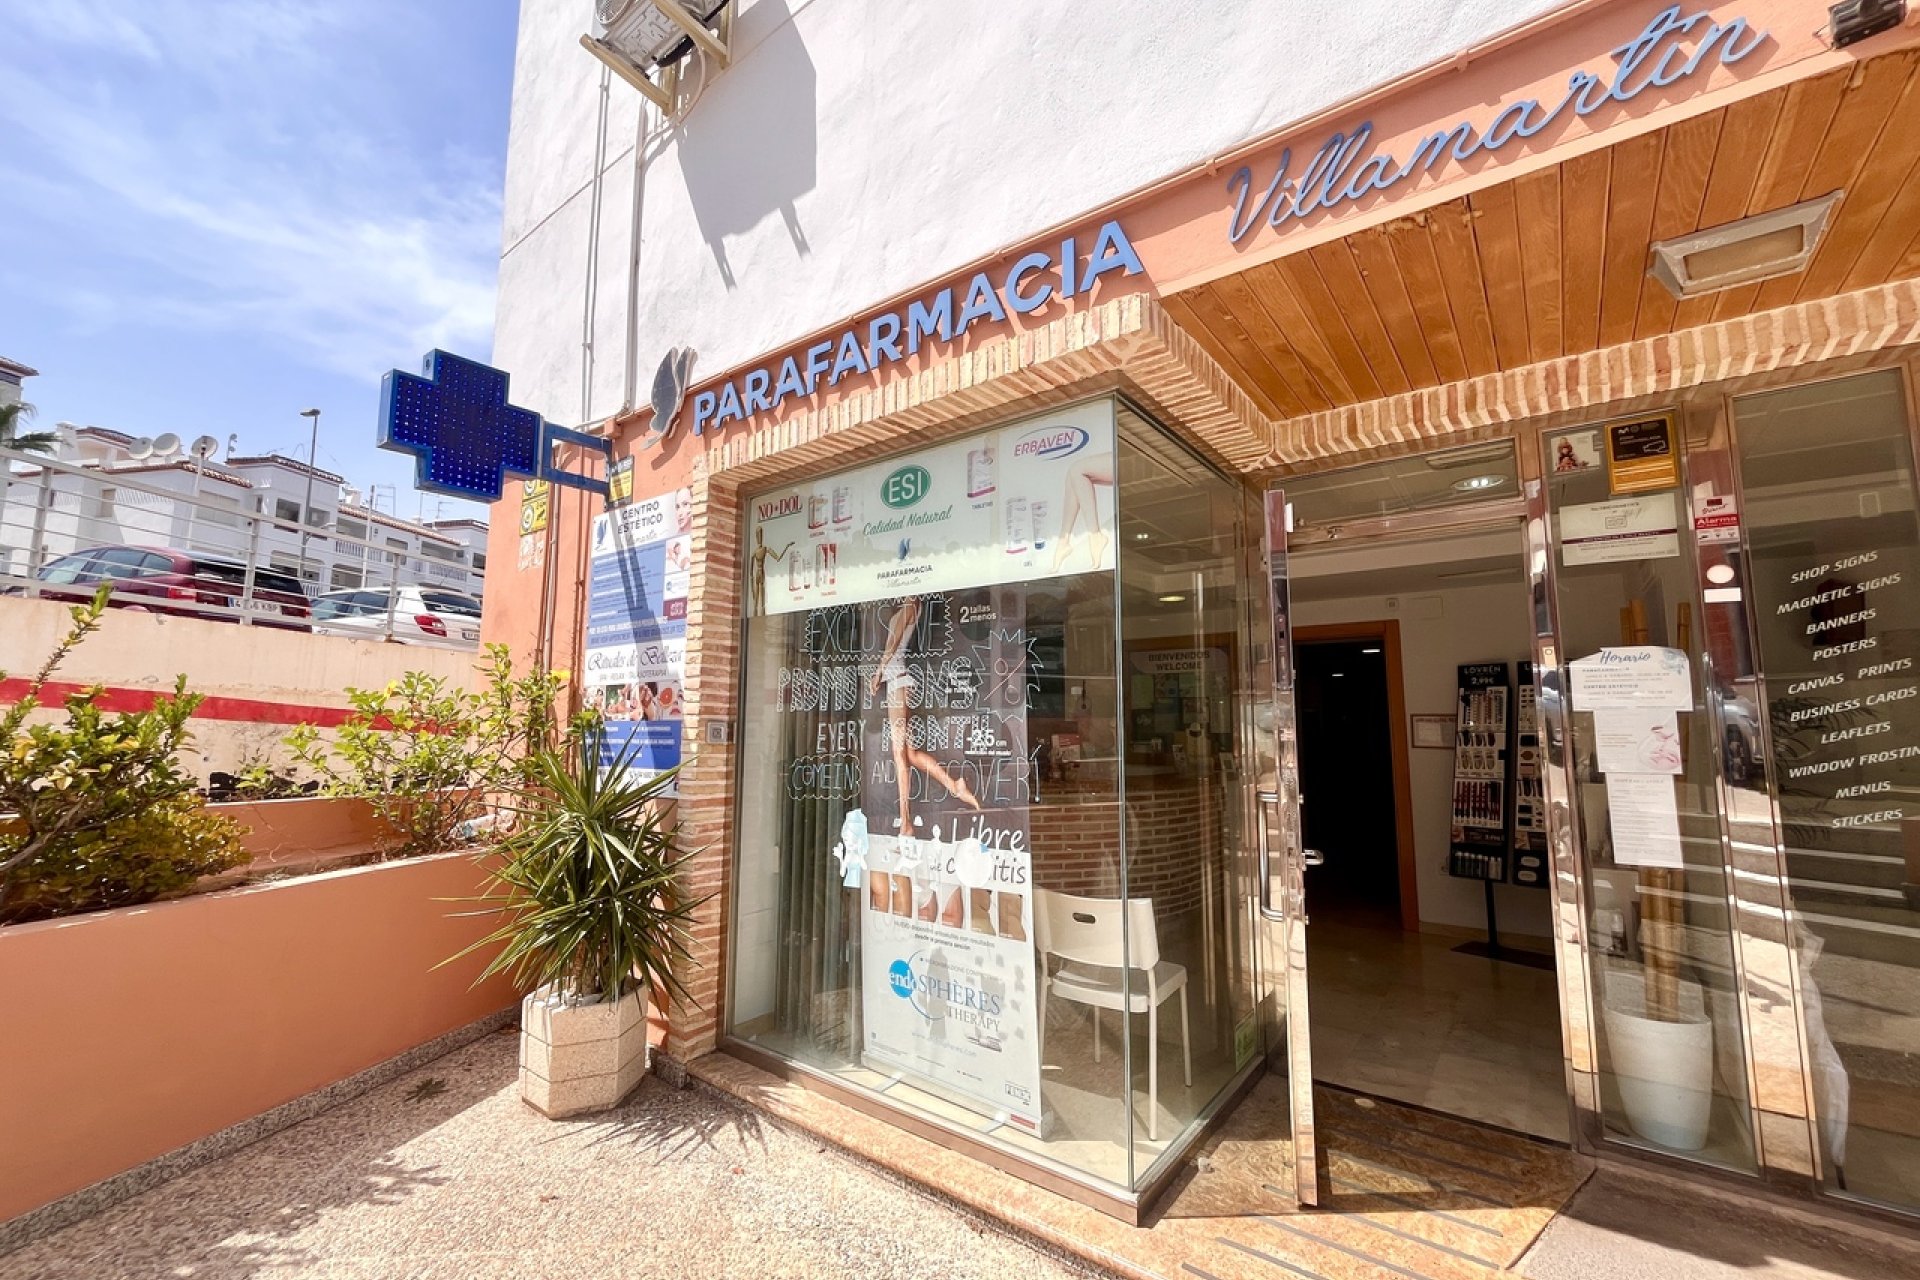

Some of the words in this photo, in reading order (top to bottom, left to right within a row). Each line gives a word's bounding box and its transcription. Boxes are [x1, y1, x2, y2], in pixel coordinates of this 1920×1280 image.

[692, 220, 1145, 436] PARAFARMACIA
[1014, 431, 1075, 457] ERBAVEN
[889, 472, 922, 502] ESI
[623, 501, 660, 520] CENTRO
[863, 519, 902, 536] Calidad
[907, 505, 953, 526] Natural
[877, 564, 933, 580] PARAFARMACIA
[1790, 564, 1830, 584] SHOP
[1833, 550, 1879, 572] SIGNS
[1776, 585, 1852, 615] MAGNETIC
[1856, 572, 1902, 594] SIGNS
[959, 606, 970, 624] 2
[970, 604, 990, 613] tallas
[970, 613, 997, 622] menos
[1805, 608, 1877, 635] BANNERS
[1149, 649, 1210, 662] BIENVENIDOS
[1600, 650, 1651, 664] Horario
[1812, 636, 1878, 661] POSTERS
[1787, 673, 1845, 695] CANVAS
[1857, 658, 1912, 679] PRINTS
[1790, 698, 1861, 722] BUSINESS
[1866, 686, 1918, 706] CARDS
[816, 719, 865, 754] EVERY
[881, 714, 990, 753] MONTH
[1821, 721, 1891, 744] LEAFLETS
[871, 763, 897, 784] AND
[1788, 757, 1855, 779] WINDOW
[1835, 780, 1891, 799] MENUS
[1832, 809, 1903, 829] STICKERS
[952, 815, 1024, 852] Libre
[945, 855, 1026, 884] Citis
[918, 974, 1000, 1016] SPHÈRES
[948, 1004, 1001, 1032] THERAPY
